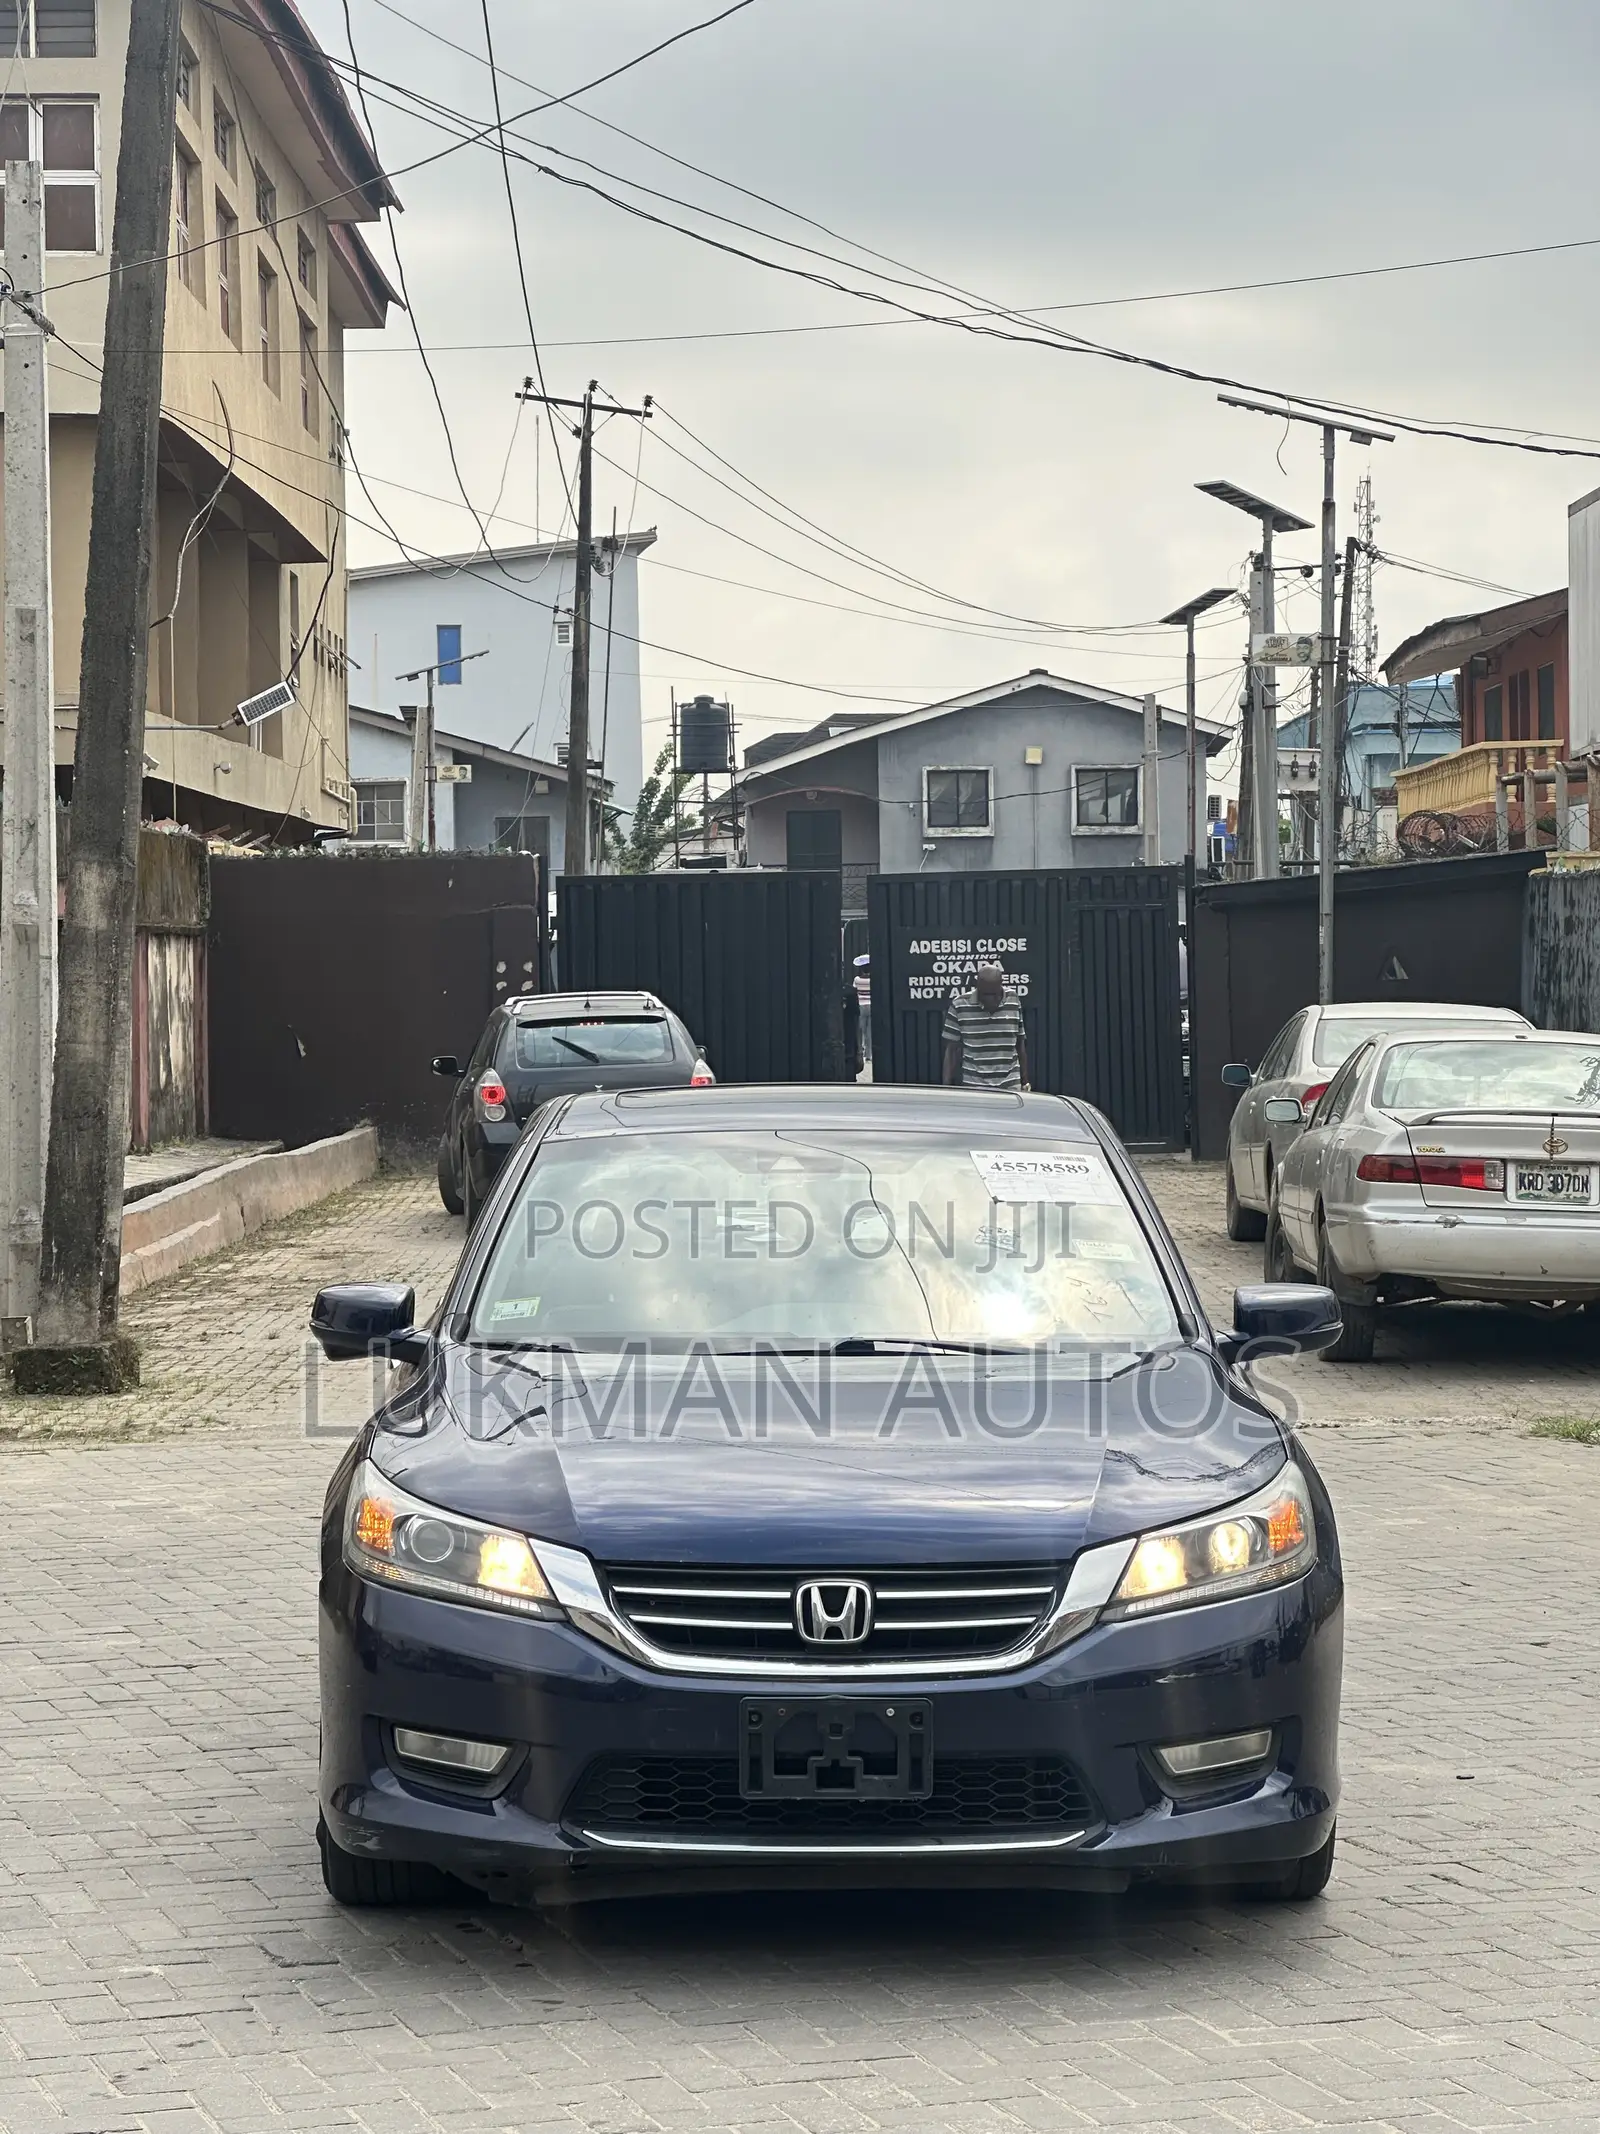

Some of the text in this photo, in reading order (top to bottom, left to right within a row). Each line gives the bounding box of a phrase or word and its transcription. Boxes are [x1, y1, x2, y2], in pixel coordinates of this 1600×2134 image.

[909, 938, 1027, 954] ADEBISI CLOSE
[908, 975, 962, 986] RIDING
[910, 987, 945, 999] NOT
[990, 1161, 1090, 1175] 45578589
